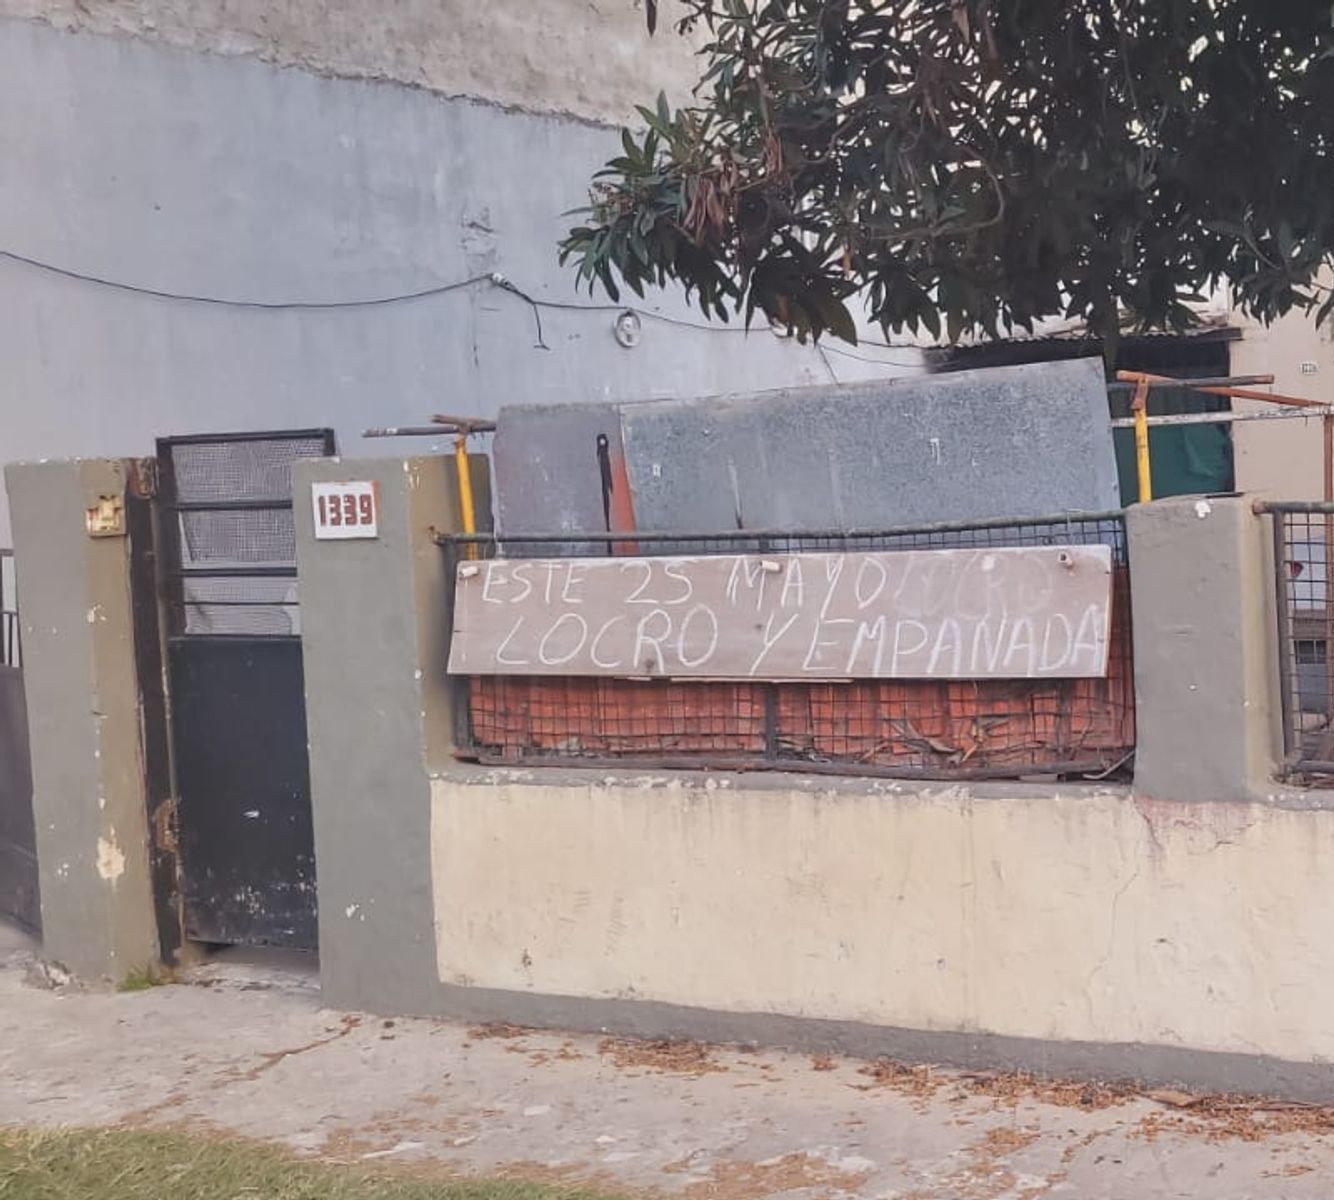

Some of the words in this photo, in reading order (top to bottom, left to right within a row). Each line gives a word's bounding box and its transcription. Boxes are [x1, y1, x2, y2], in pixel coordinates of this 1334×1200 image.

[318, 493, 373, 526] 1339
[482, 562, 586, 603] ESTE
[727, 555, 887, 618] MAYO
[496, 604, 718, 675] LOCRO
[749, 613, 799, 676] Y
[803, 604, 1107, 677] EMPANADA
